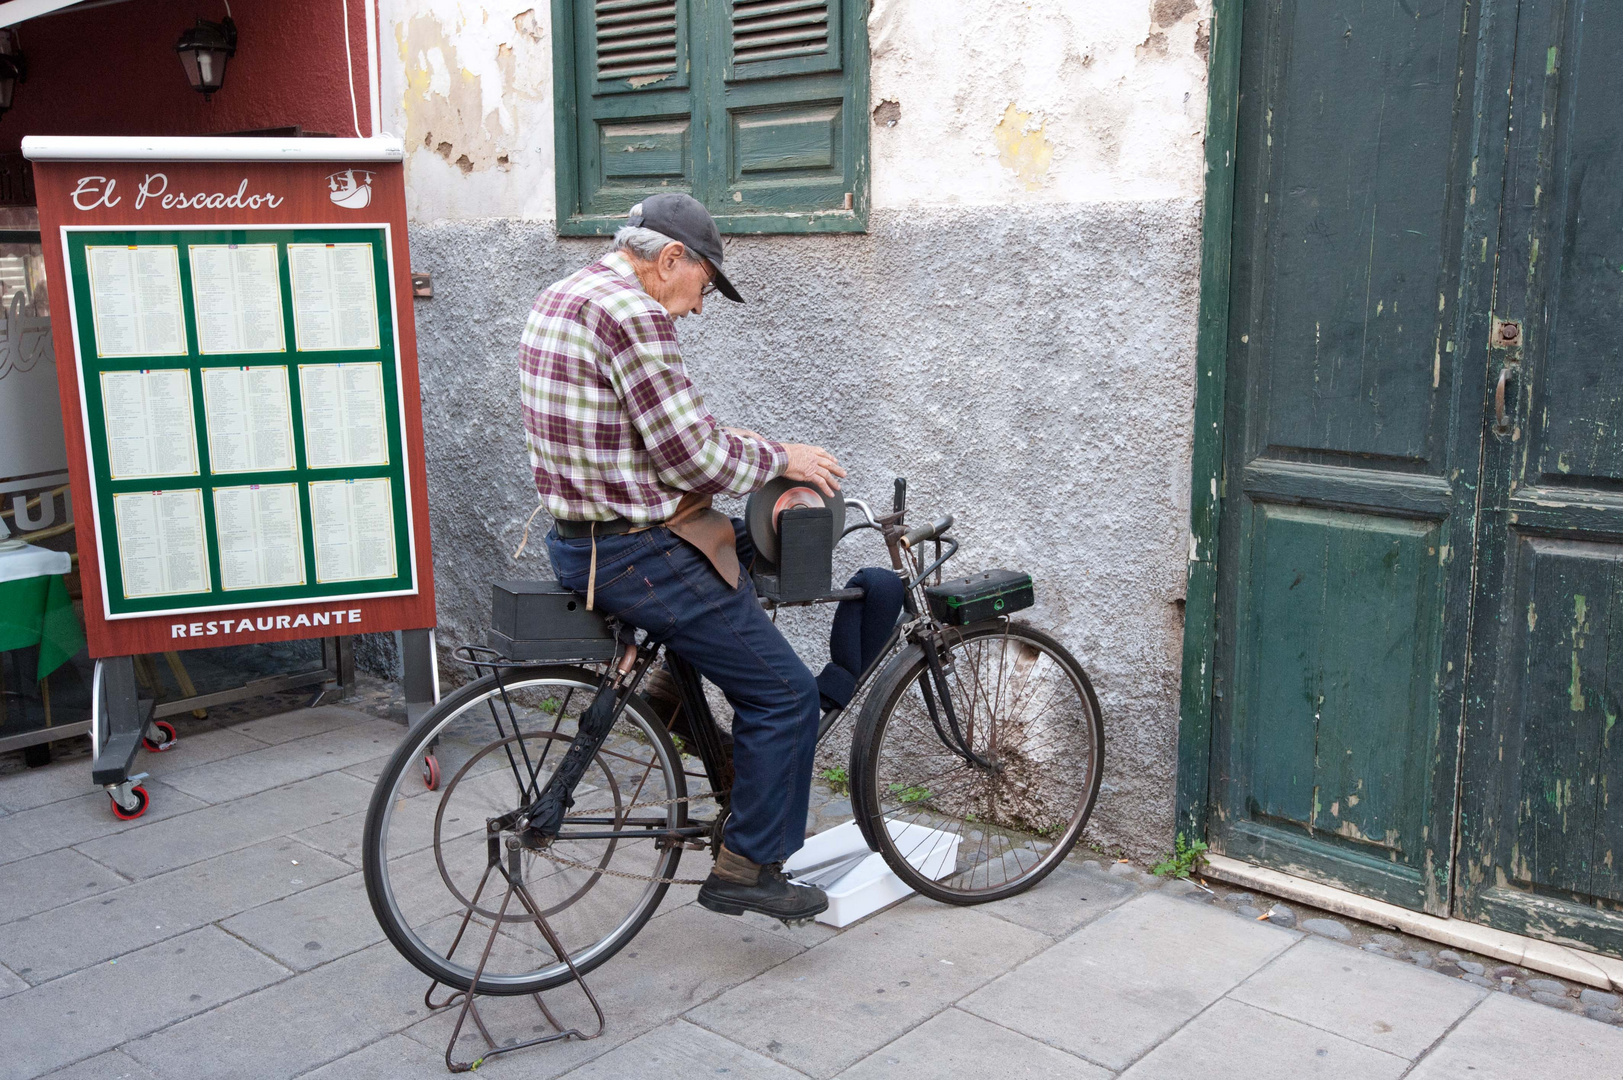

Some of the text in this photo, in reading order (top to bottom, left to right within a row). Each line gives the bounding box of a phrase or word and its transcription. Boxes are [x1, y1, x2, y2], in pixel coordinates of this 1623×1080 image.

[70, 173, 284, 211] El Pescador
[171, 609, 362, 639] RESTAURANTE
